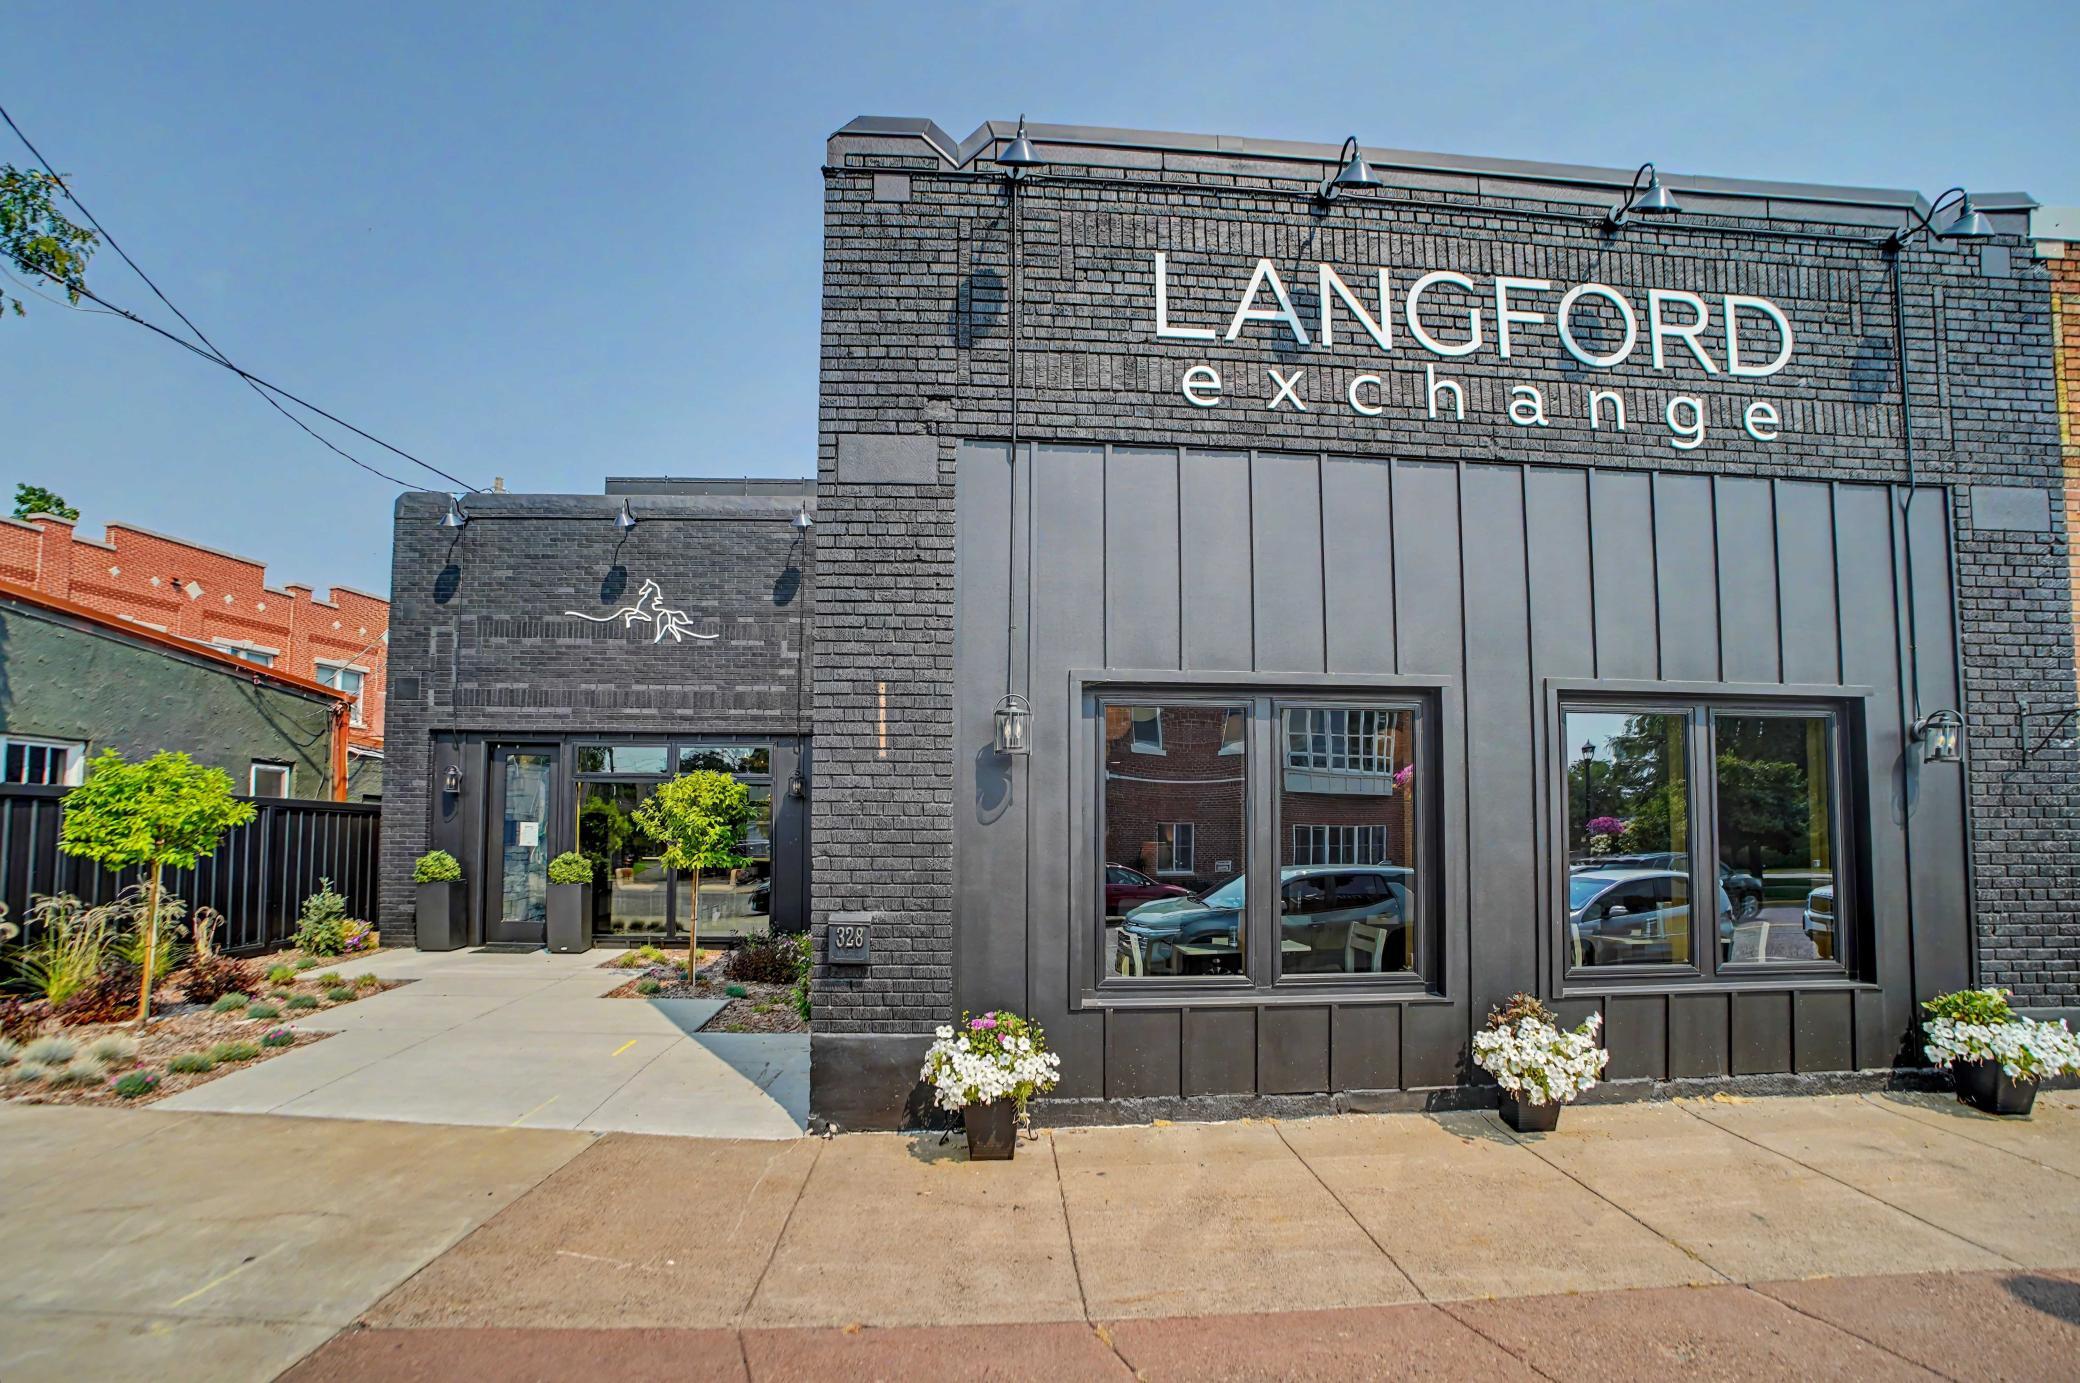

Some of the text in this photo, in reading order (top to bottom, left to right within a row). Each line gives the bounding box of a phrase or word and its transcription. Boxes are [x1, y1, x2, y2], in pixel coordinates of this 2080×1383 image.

[1154, 251, 1793, 377] LANGFORD
[1182, 363, 1780, 450] exchange
[836, 926, 864, 948] 328
